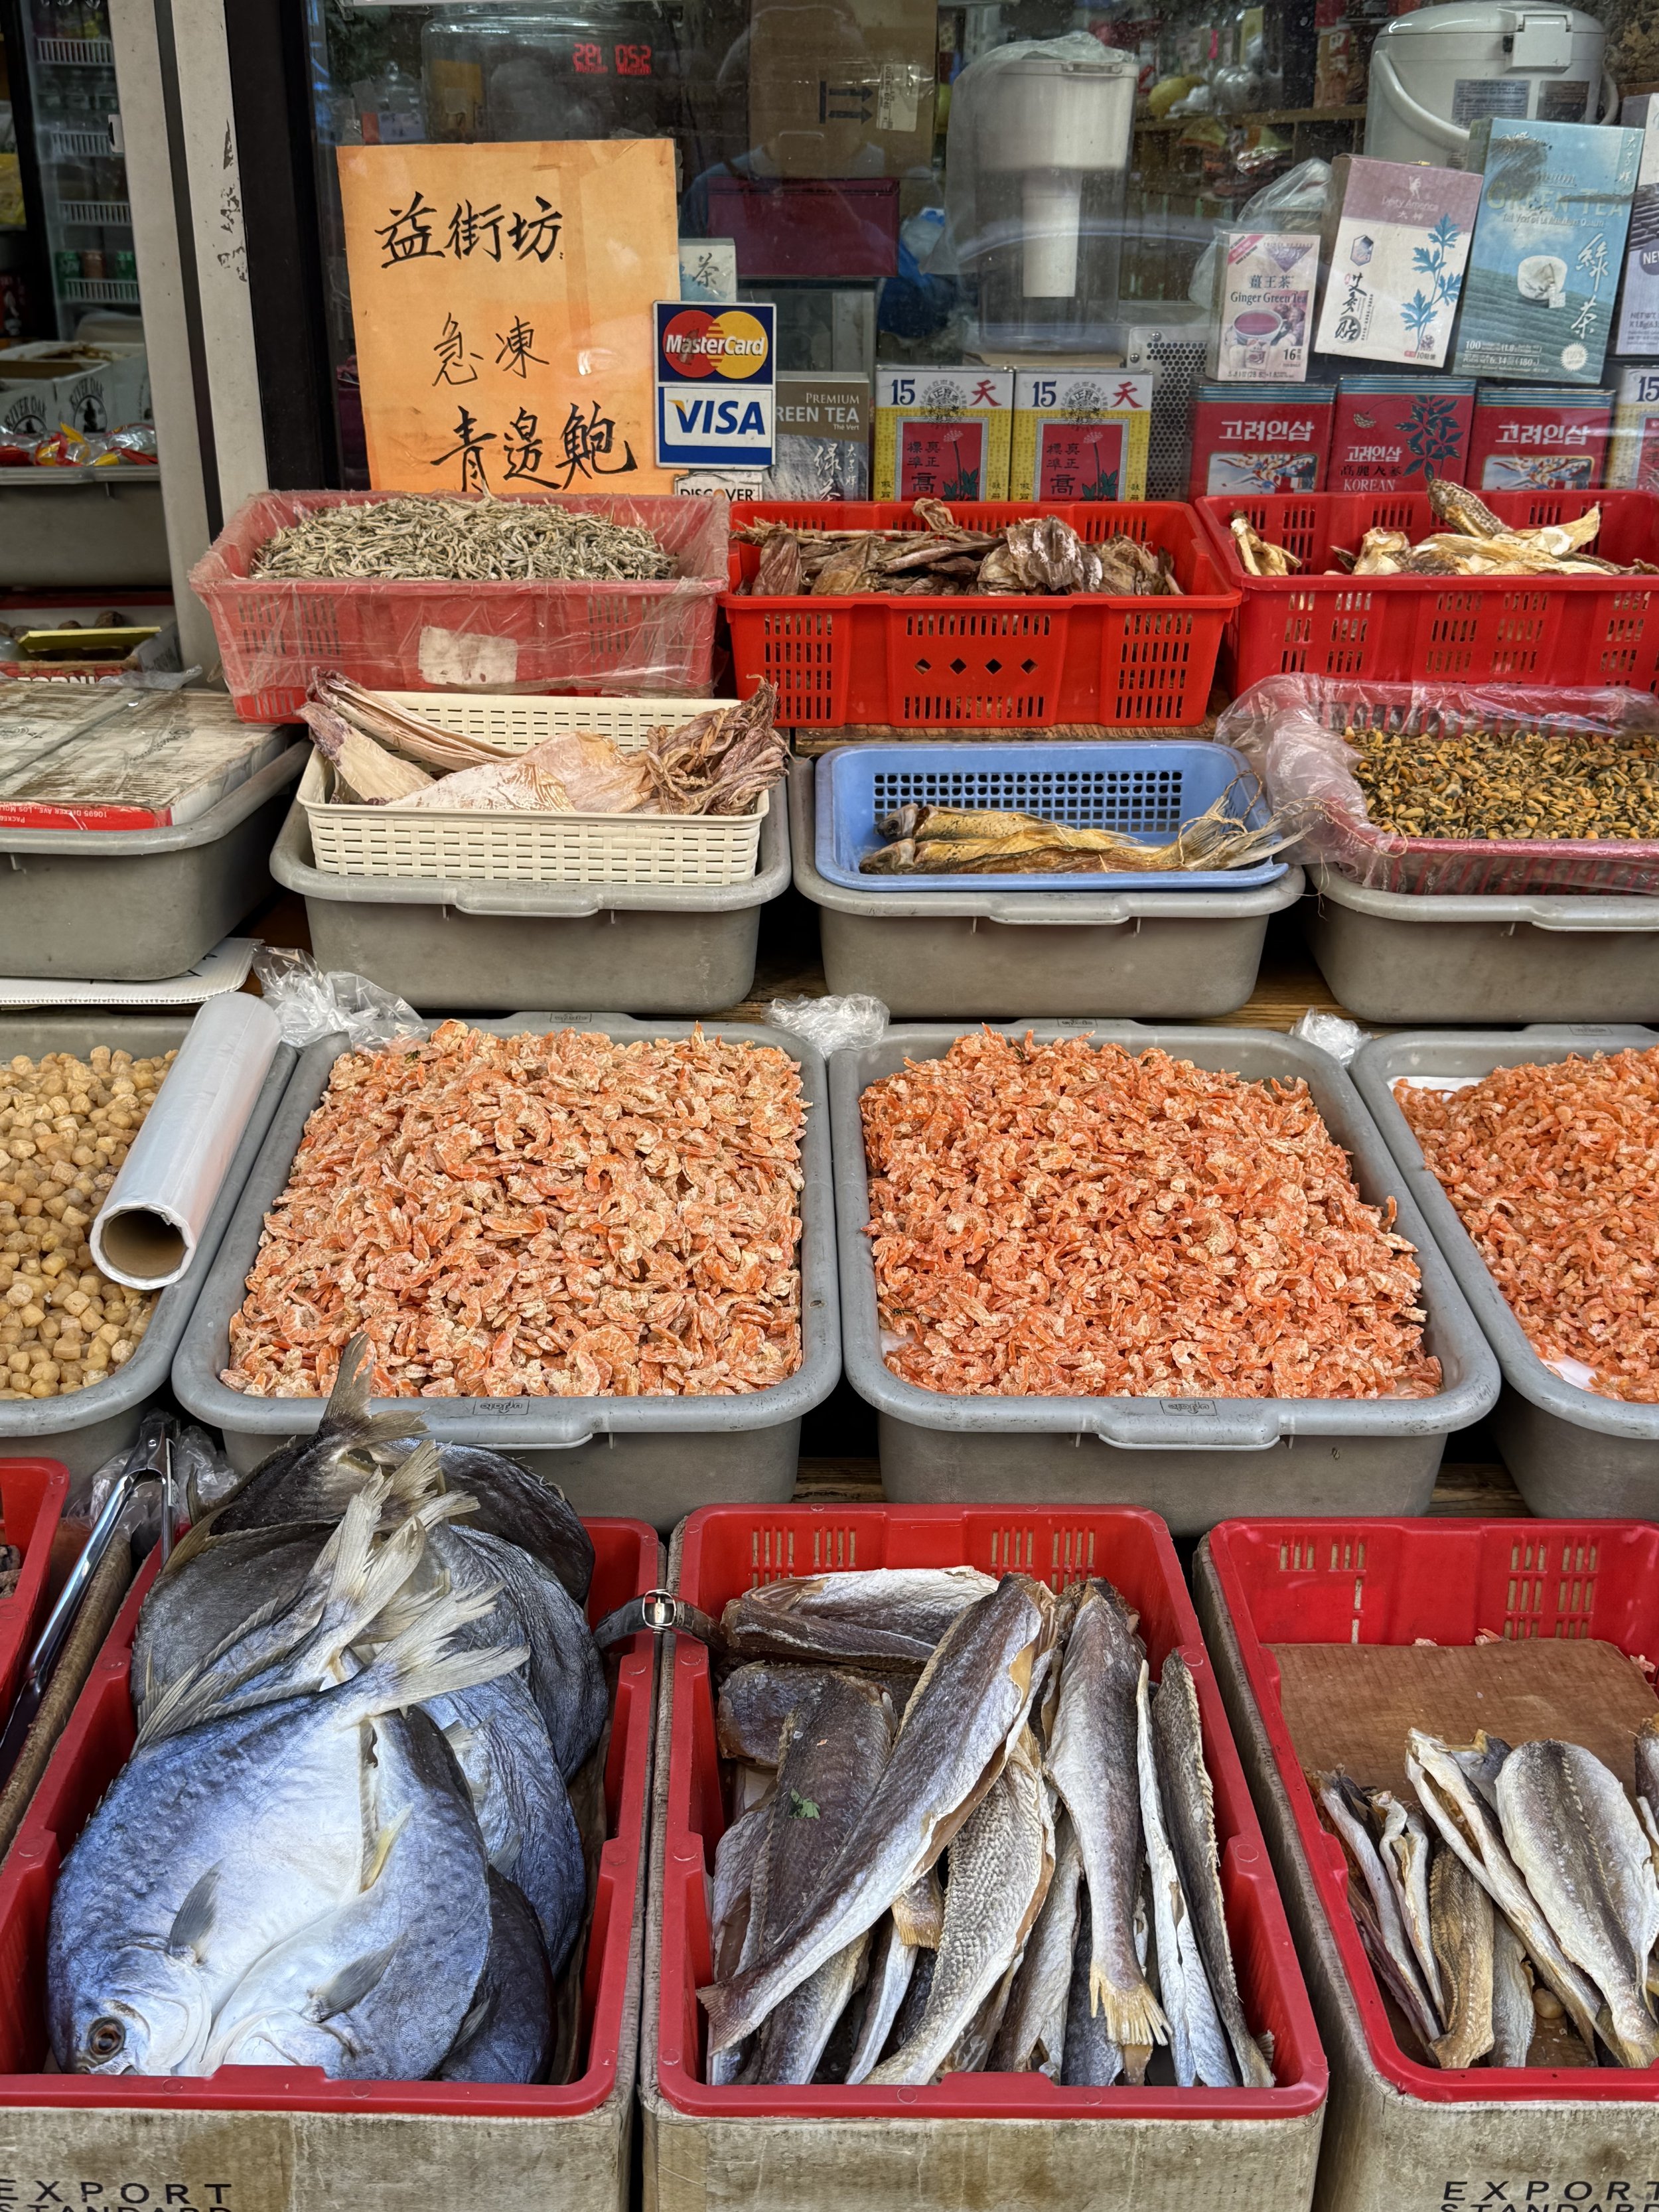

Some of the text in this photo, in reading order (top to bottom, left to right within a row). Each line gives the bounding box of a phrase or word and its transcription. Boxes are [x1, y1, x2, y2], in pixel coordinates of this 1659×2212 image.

[1580, 188, 1623, 217] TEA
[1643, 251, 1659, 265] NE
[692, 252, 720, 288] 茶
[1230, 292, 1308, 305] Ginger Green Tea
[665, 334, 766, 356] MasterCard
[1283, 348, 1296, 360] 16
[1466, 340, 1481, 350] 100
[806, 392, 859, 404] PREMIUM
[891, 379, 915, 406] 15
[969, 380, 1002, 407] 天
[1032, 380, 1056, 407] 15
[1110, 382, 1143, 409] 天
[1636, 376, 1659, 402] 15
[668, 400, 766, 435] VISA
[776, 406, 859, 423] REEN TEA
[1218, 420, 1315, 441] 고려인삼
[1494, 423, 1591, 445] 고려인삼
[1344, 446, 1403, 462] 고려인삼
[1343, 479, 1396, 491] KOREAN
[0, 2179, 232, 2204] EXPORT
